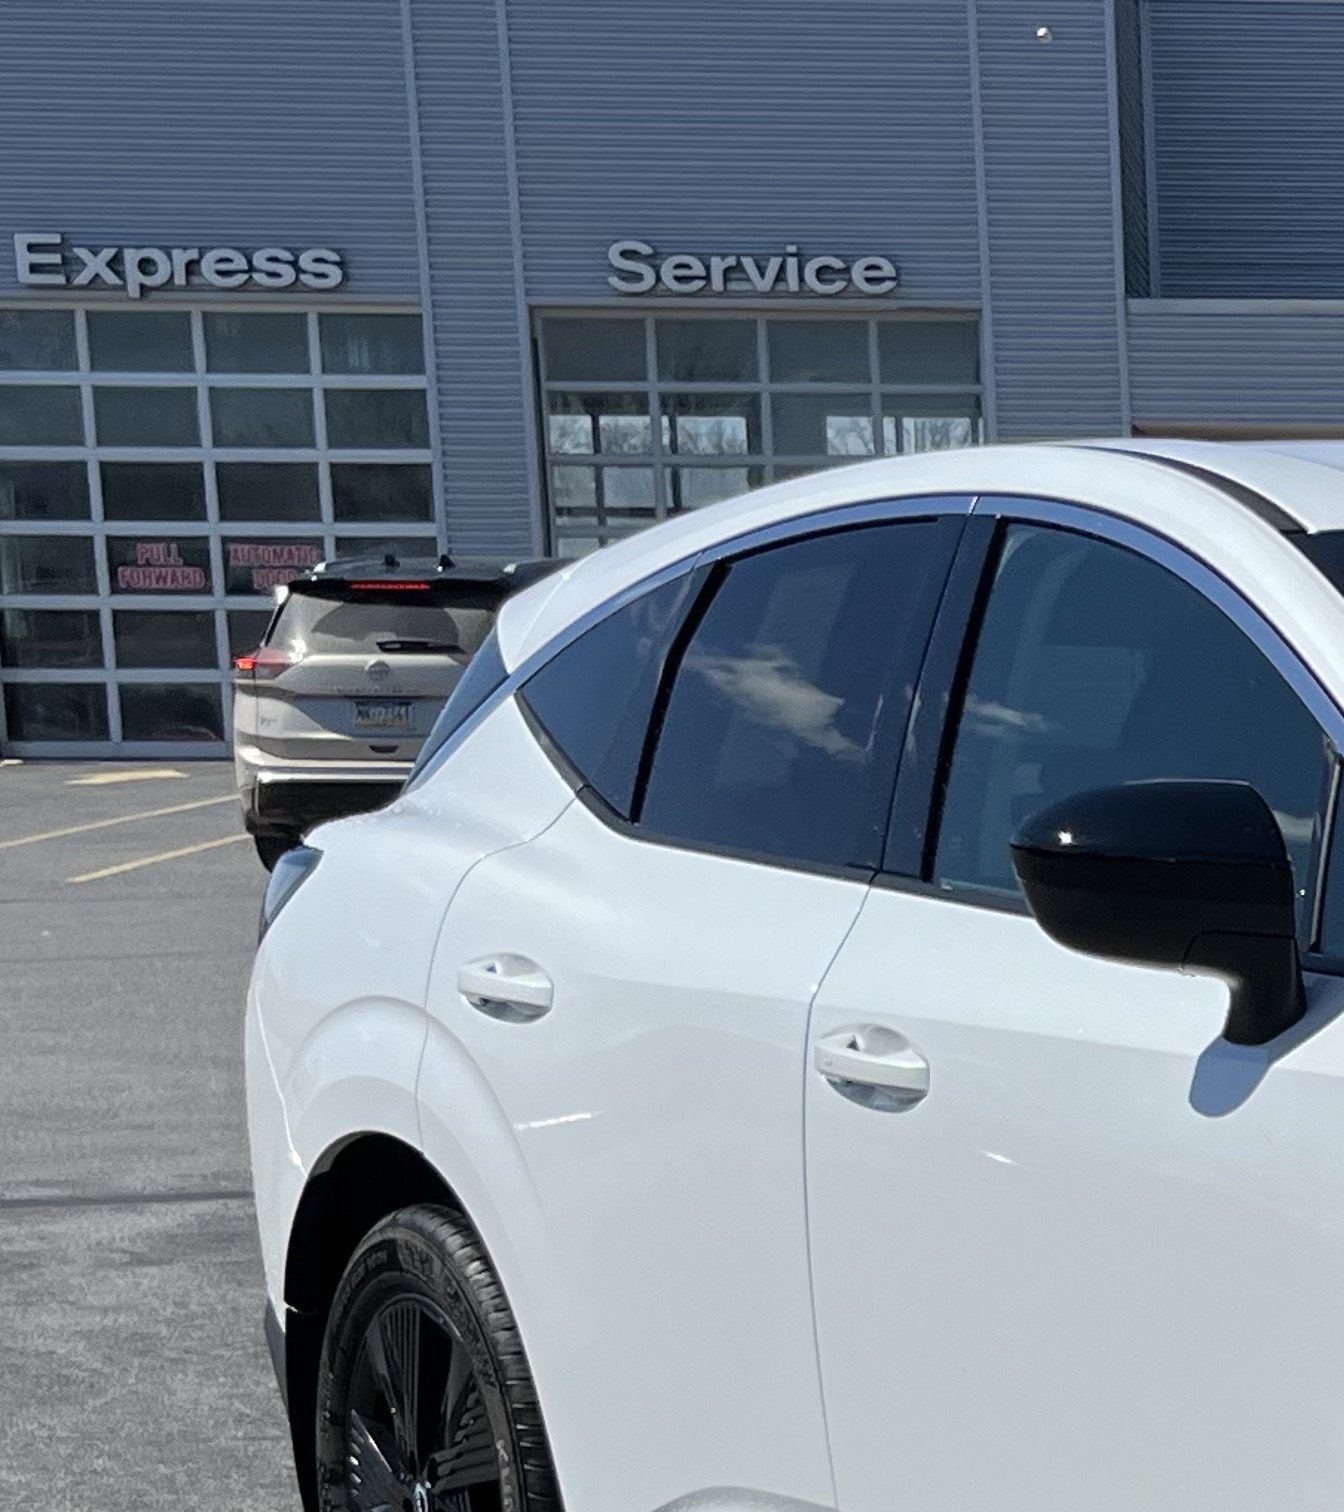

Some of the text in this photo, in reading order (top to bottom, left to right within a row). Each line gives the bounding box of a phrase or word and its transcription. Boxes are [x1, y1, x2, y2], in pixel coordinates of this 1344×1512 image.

[13, 232, 898, 298] Express Service
[136, 543, 184, 566] PULL
[117, 566, 206, 590] FORWARD
